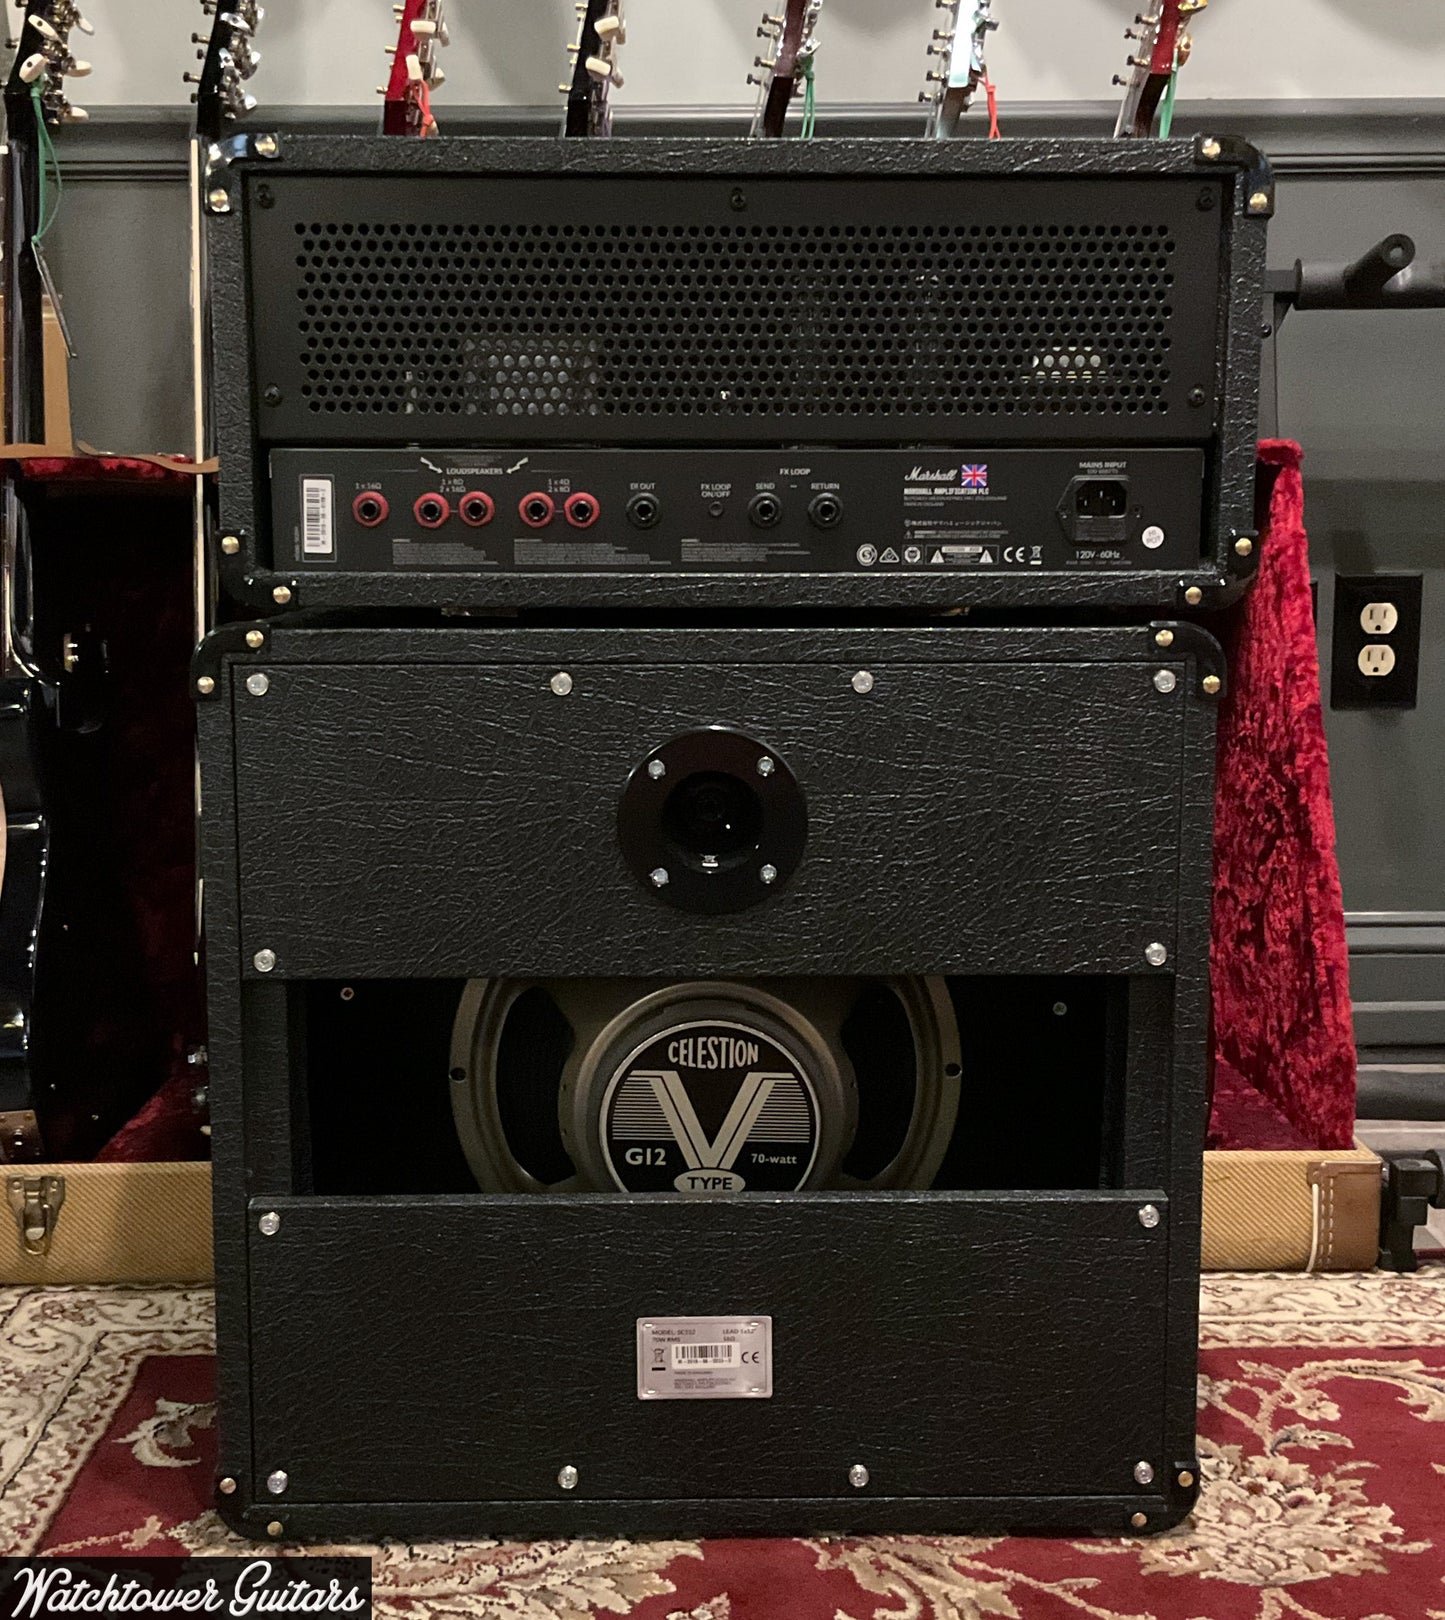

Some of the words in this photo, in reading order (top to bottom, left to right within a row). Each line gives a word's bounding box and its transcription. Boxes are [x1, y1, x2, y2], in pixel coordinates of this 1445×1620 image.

[446, 467, 503, 475] LOUDSPEAKERS
[904, 466, 958, 481] Marshall
[640, 482, 656, 490] OUT
[755, 482, 776, 490] SEND
[810, 482, 840, 490] RETURN
[668, 1036, 759, 1070] CELESTION
[625, 1148, 667, 1166] G12
[751, 1153, 797, 1164] 70-watt
[687, 1176, 732, 1190] TYPE
